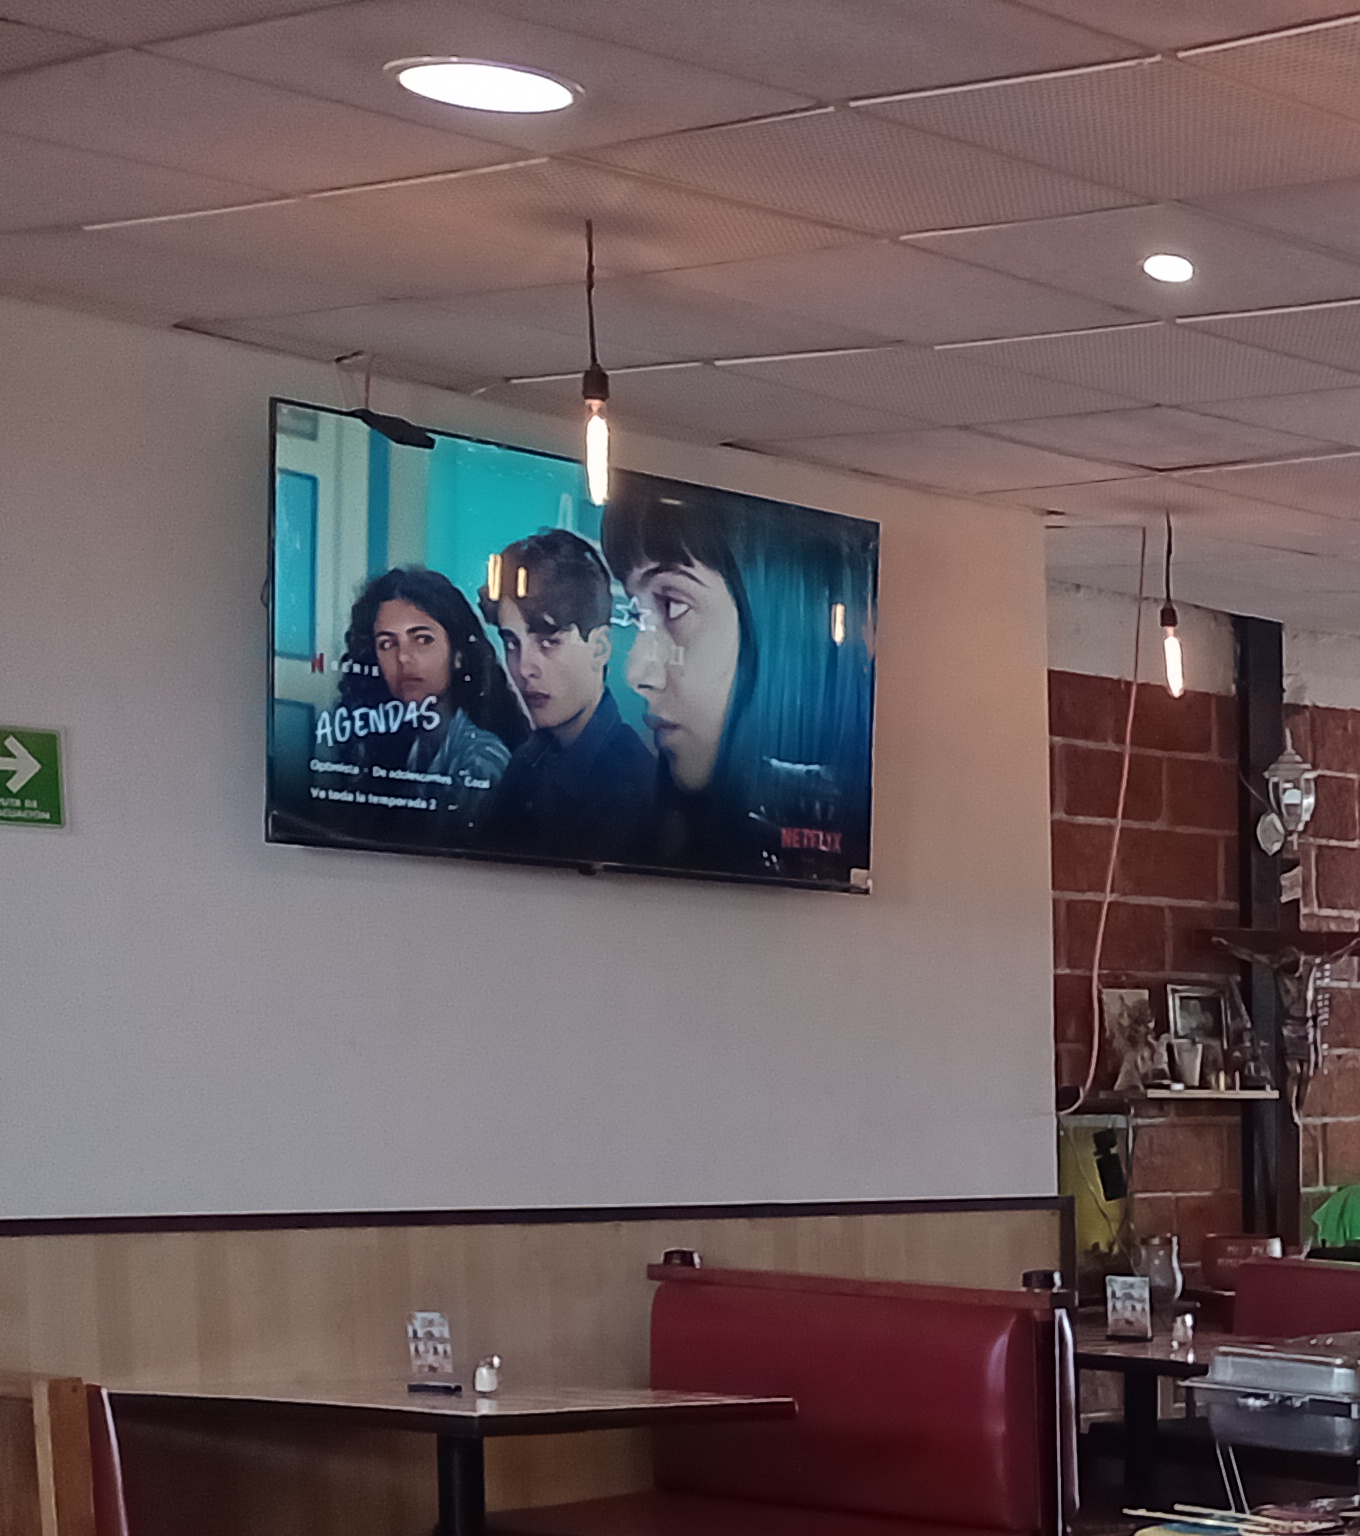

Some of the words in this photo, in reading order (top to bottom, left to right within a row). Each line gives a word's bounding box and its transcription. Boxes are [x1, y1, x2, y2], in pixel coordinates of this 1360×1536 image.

[315, 695, 441, 747] AGENDAS
[372, 765, 388, 778] De
[328, 788, 354, 802] toda
[367, 792, 428, 810] temporada
[781, 826, 843, 853] NETFLIX
